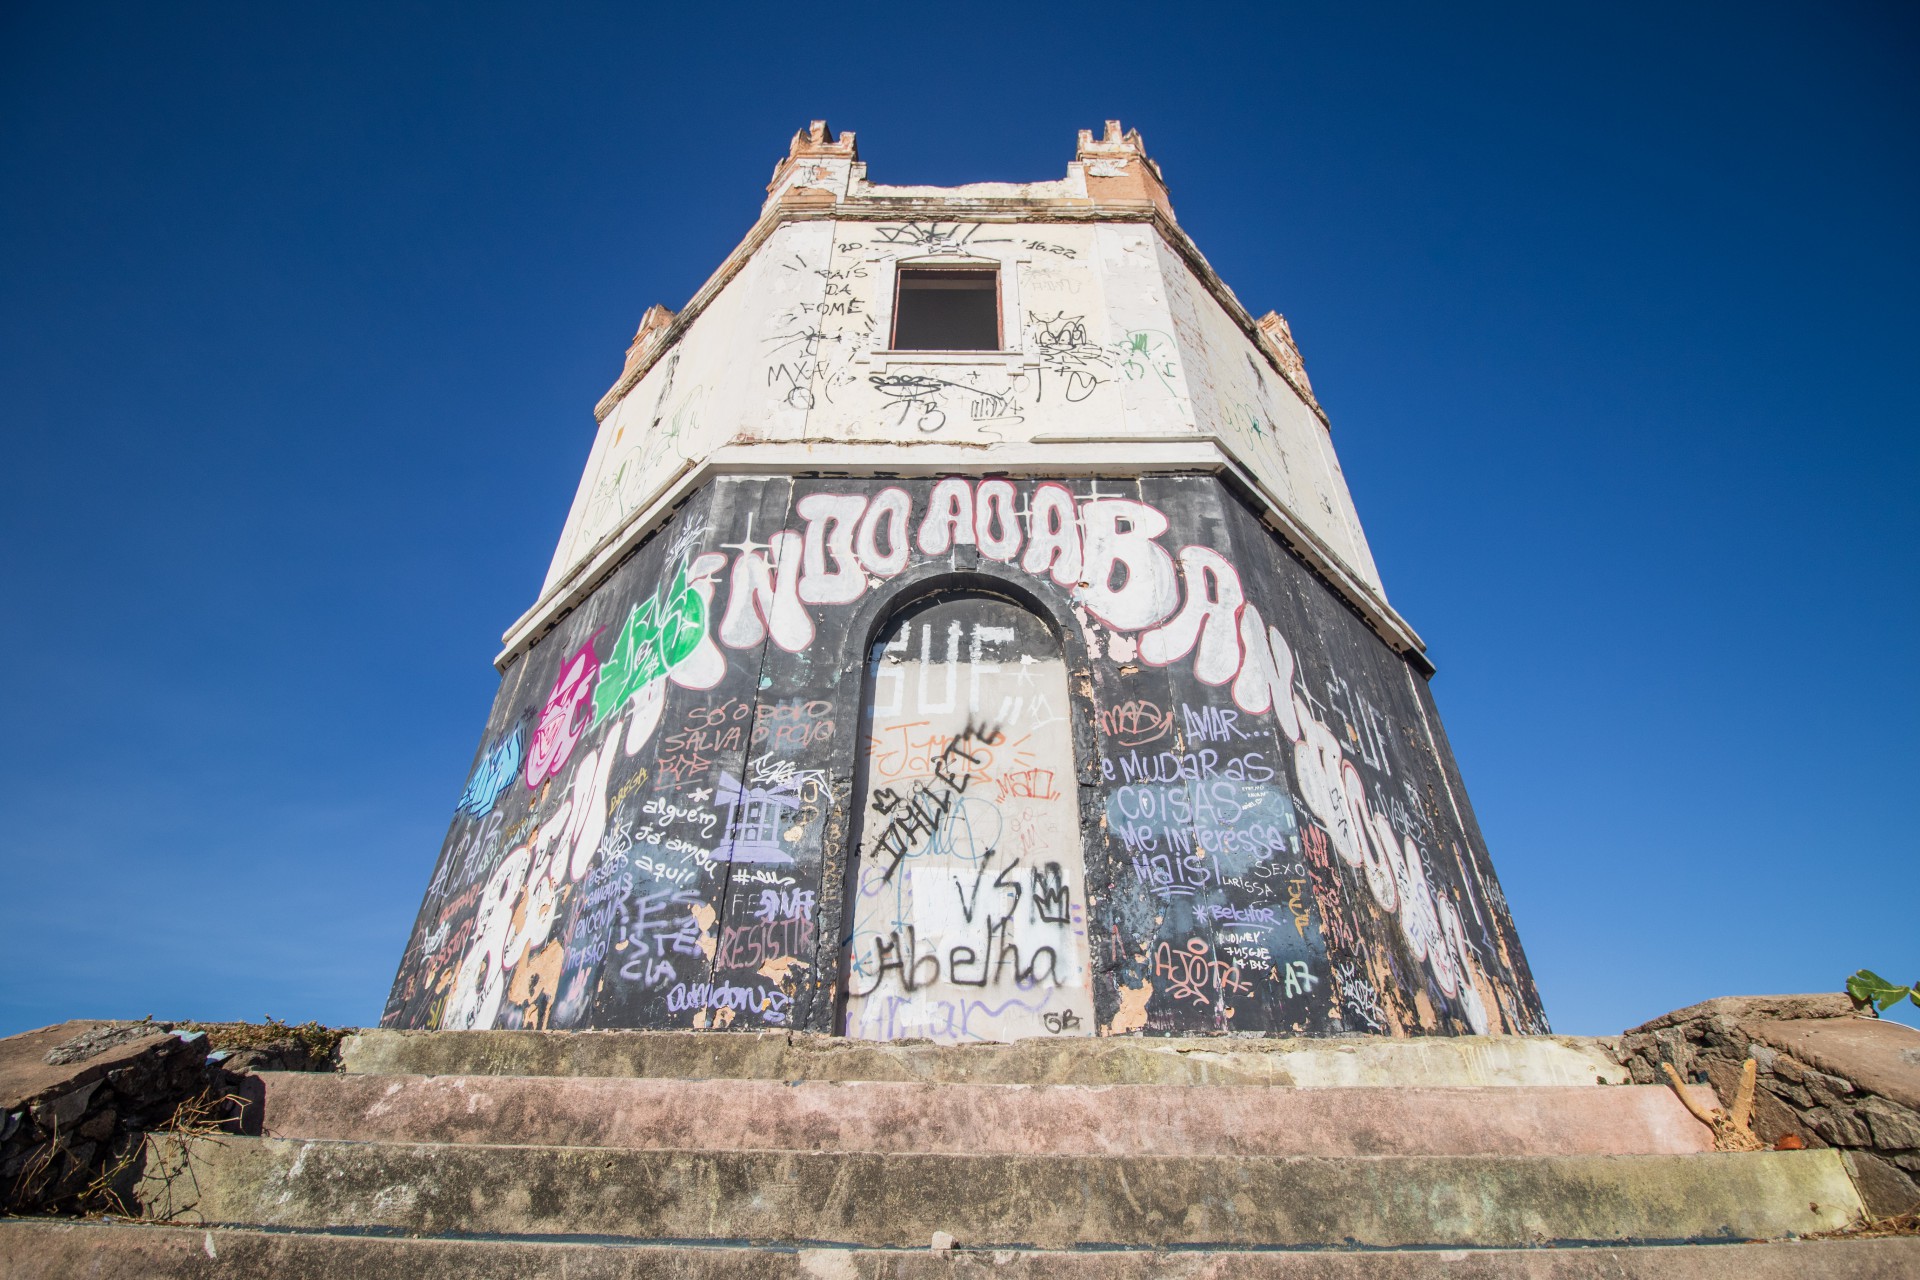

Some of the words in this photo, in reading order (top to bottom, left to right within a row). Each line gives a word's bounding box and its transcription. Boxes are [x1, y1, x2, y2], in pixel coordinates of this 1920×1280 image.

[665, 727, 741, 752] SALVA
[776, 721, 836, 749] POVO
[1254, 860, 1306, 878] SEXO
